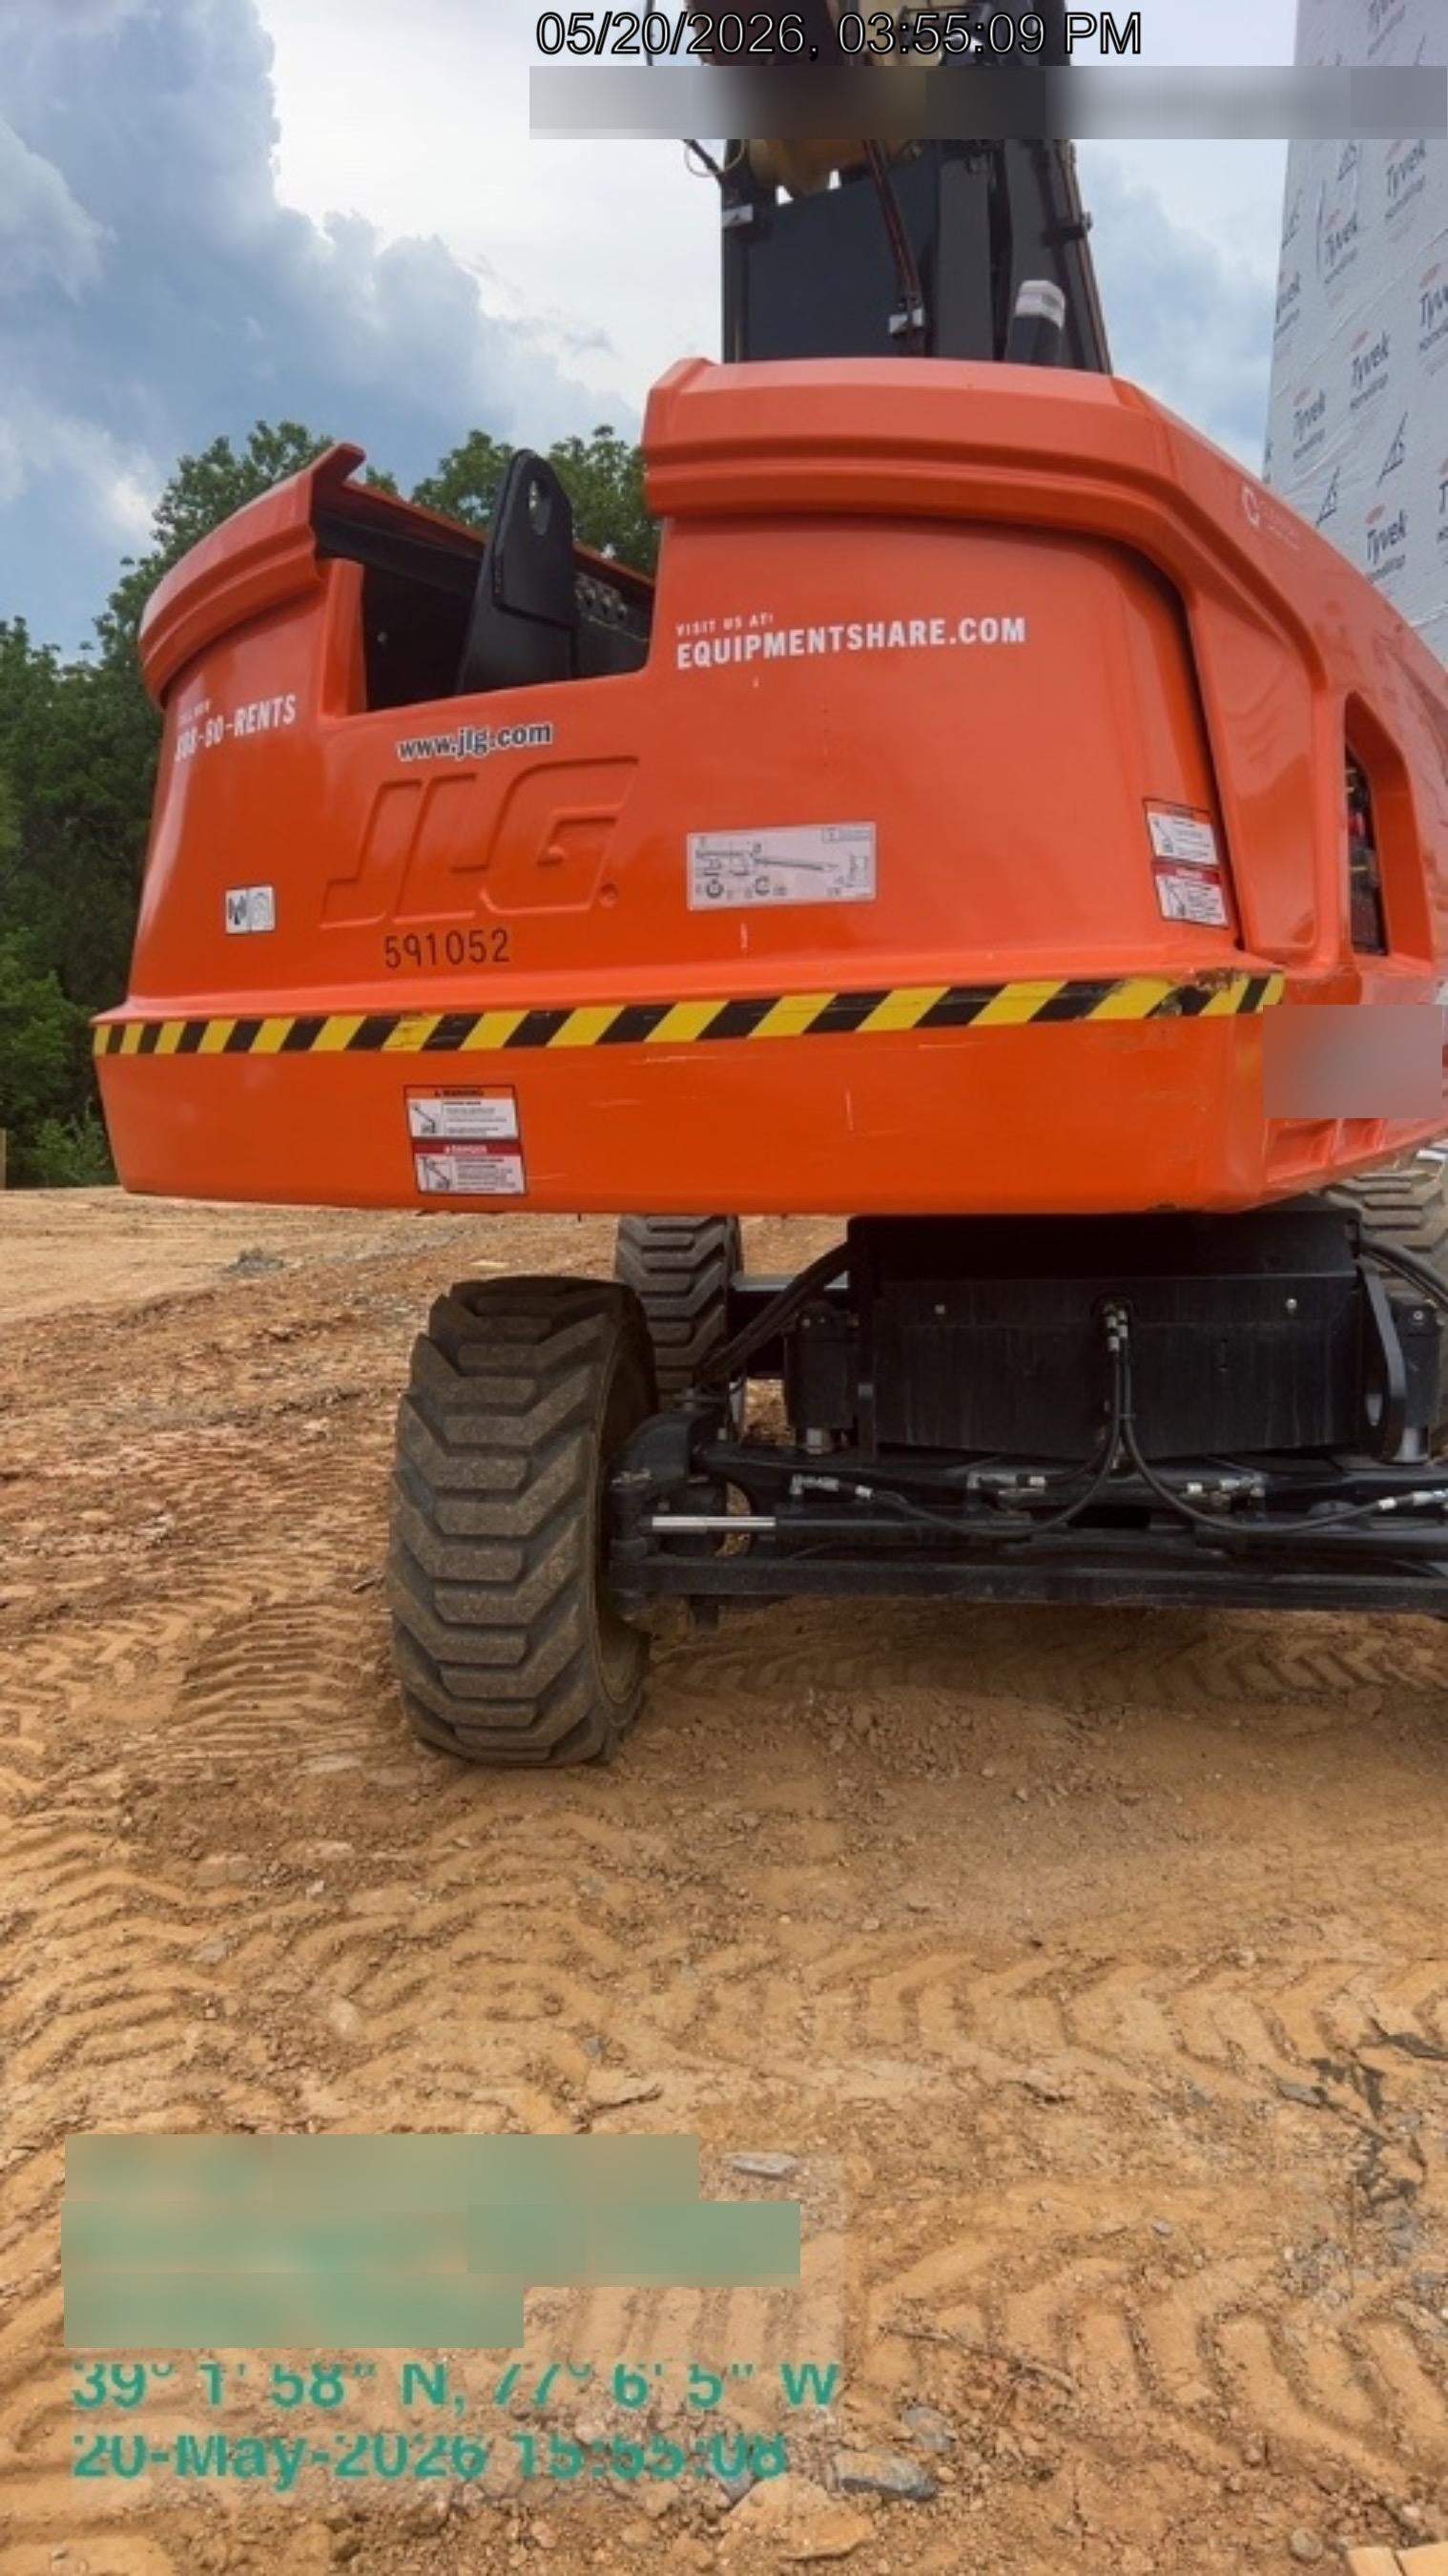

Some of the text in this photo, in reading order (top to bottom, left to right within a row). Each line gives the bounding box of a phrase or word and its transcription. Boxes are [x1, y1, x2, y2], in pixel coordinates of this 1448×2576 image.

[1367, 509, 1408, 566] Tyvek
[676, 618, 716, 637] VISIT
[723, 615, 743, 631] US
[676, 617, 1025, 670] EQUIPMENTSHARE.COM
[397, 722, 552, 761] www.jlg.com
[320, 755, 639, 929] JLG
[384, 926, 510, 969] 591052
